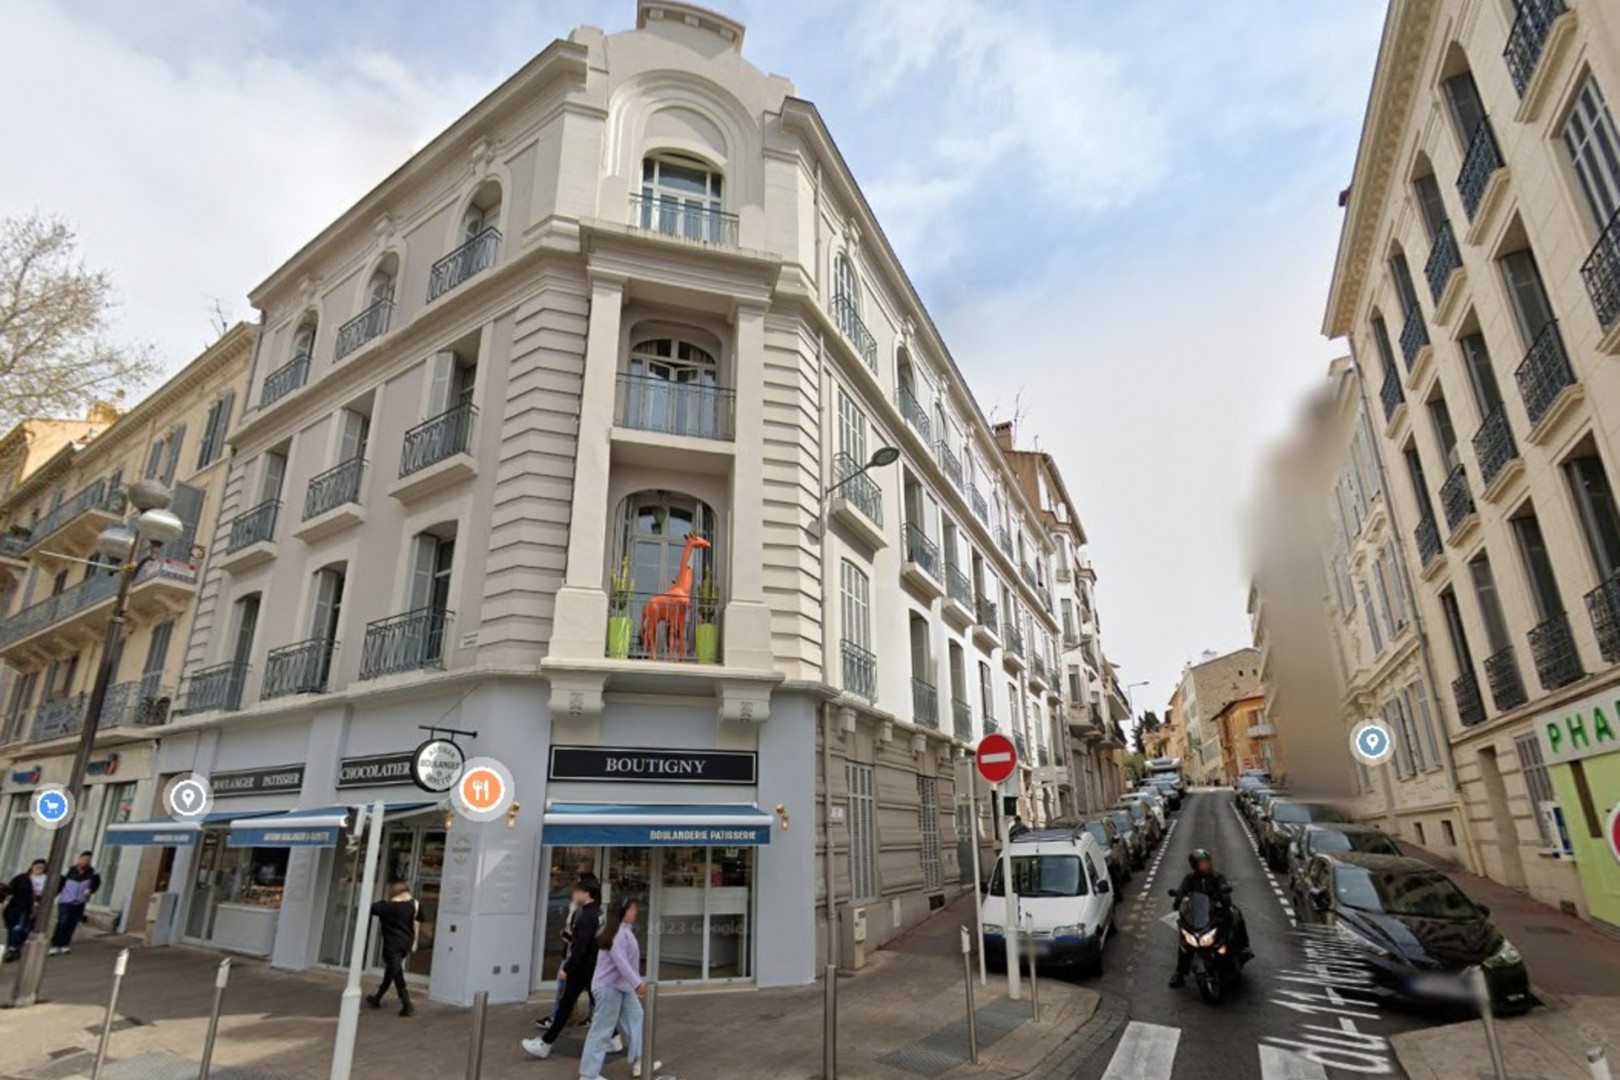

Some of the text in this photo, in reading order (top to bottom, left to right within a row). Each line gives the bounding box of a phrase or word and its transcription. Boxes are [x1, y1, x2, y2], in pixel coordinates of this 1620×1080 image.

[1546, 700, 1620, 755] PHA
[340, 761, 411, 780] CHOCOLATIER
[605, 757, 706, 774] BOUTIGNY
[650, 830, 757, 840] BOULANGERIE PATISSERIE
